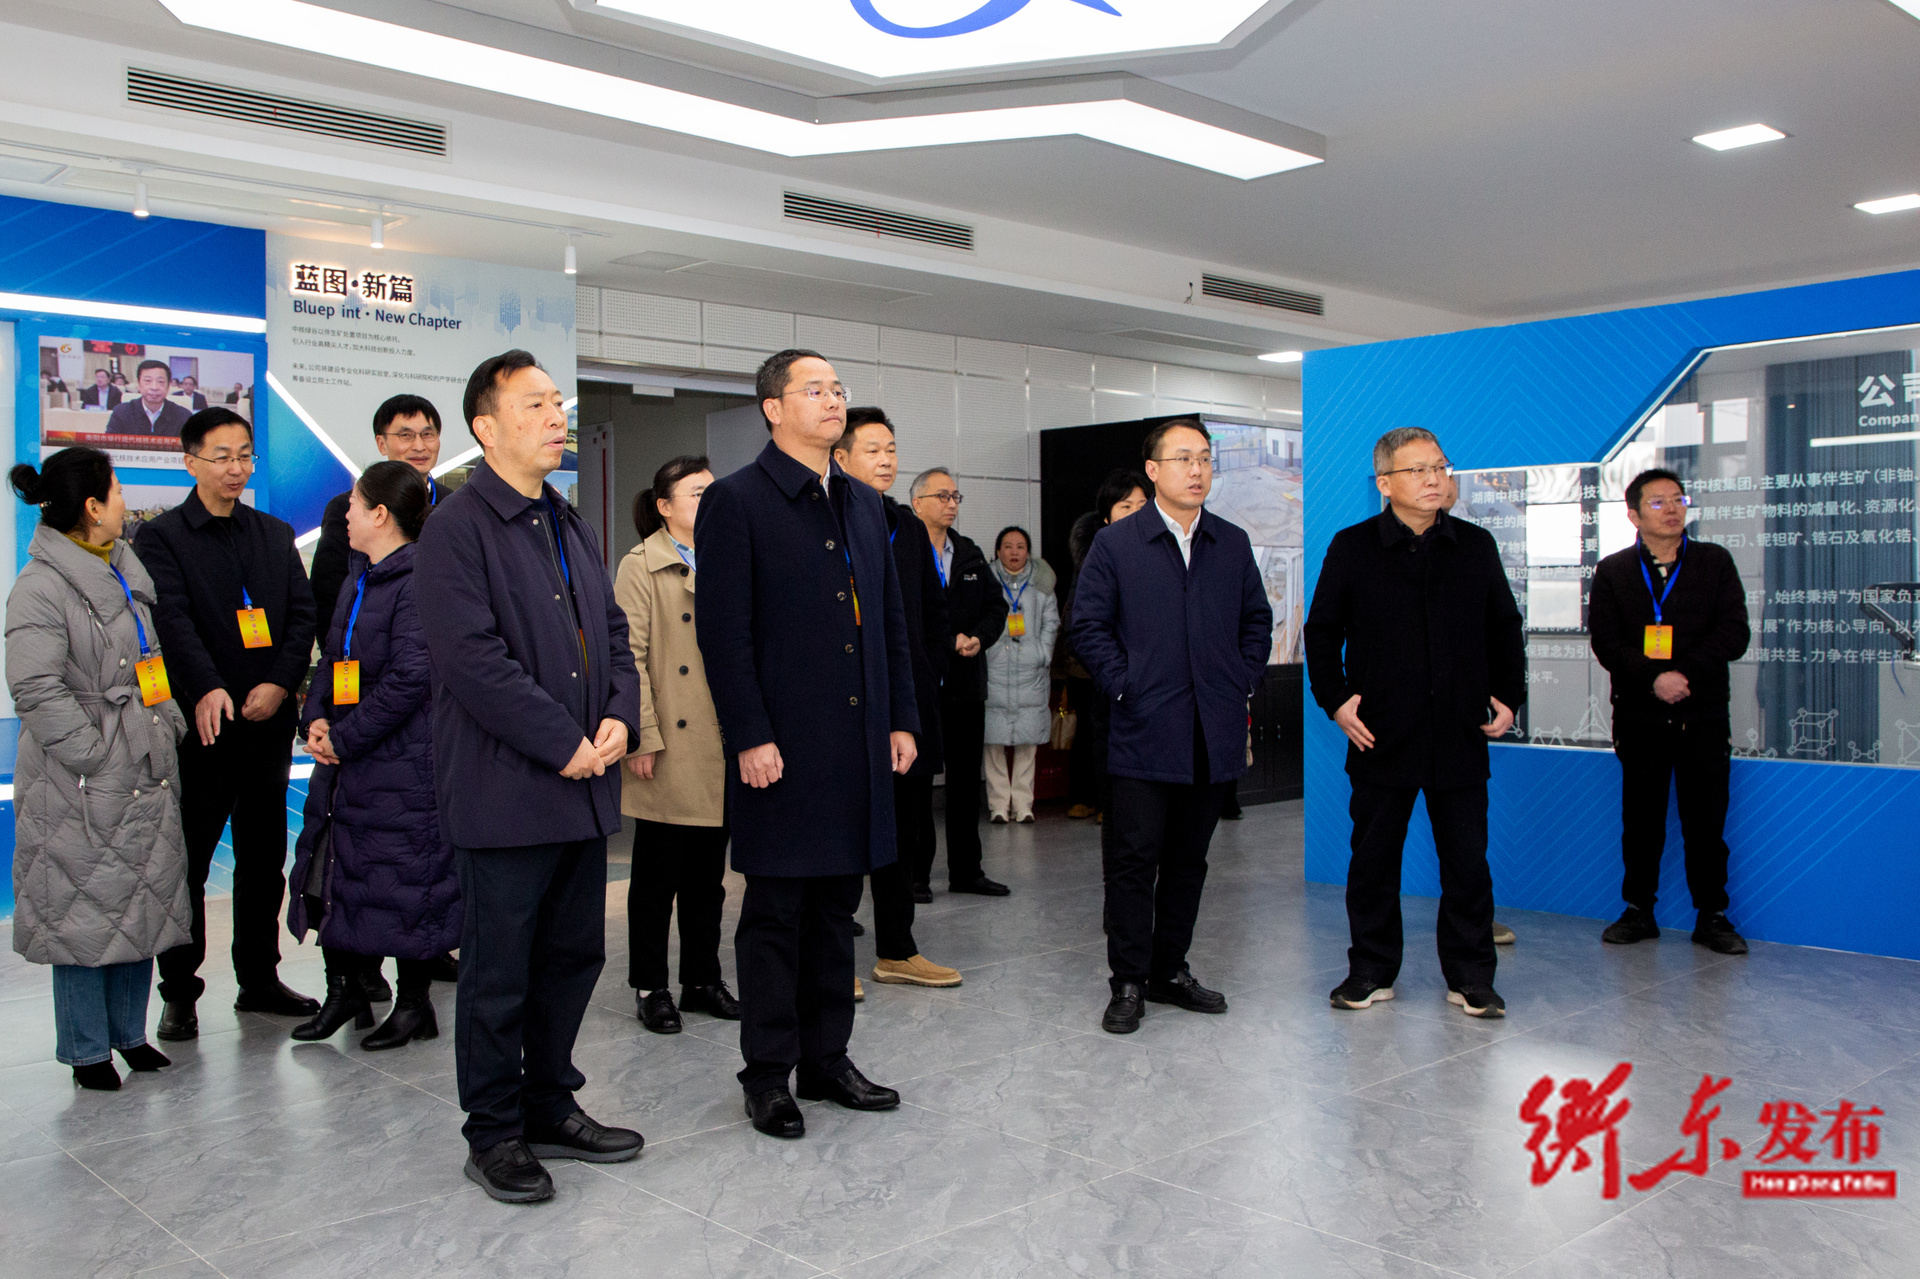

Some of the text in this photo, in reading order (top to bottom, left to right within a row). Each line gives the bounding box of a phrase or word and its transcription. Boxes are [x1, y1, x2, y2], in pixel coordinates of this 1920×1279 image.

[294, 264, 413, 303] 蓝图·新篇
[375, 309, 405, 325] New
[408, 312, 462, 331] Chapter
[1525, 670, 1560, 684] 水平。
